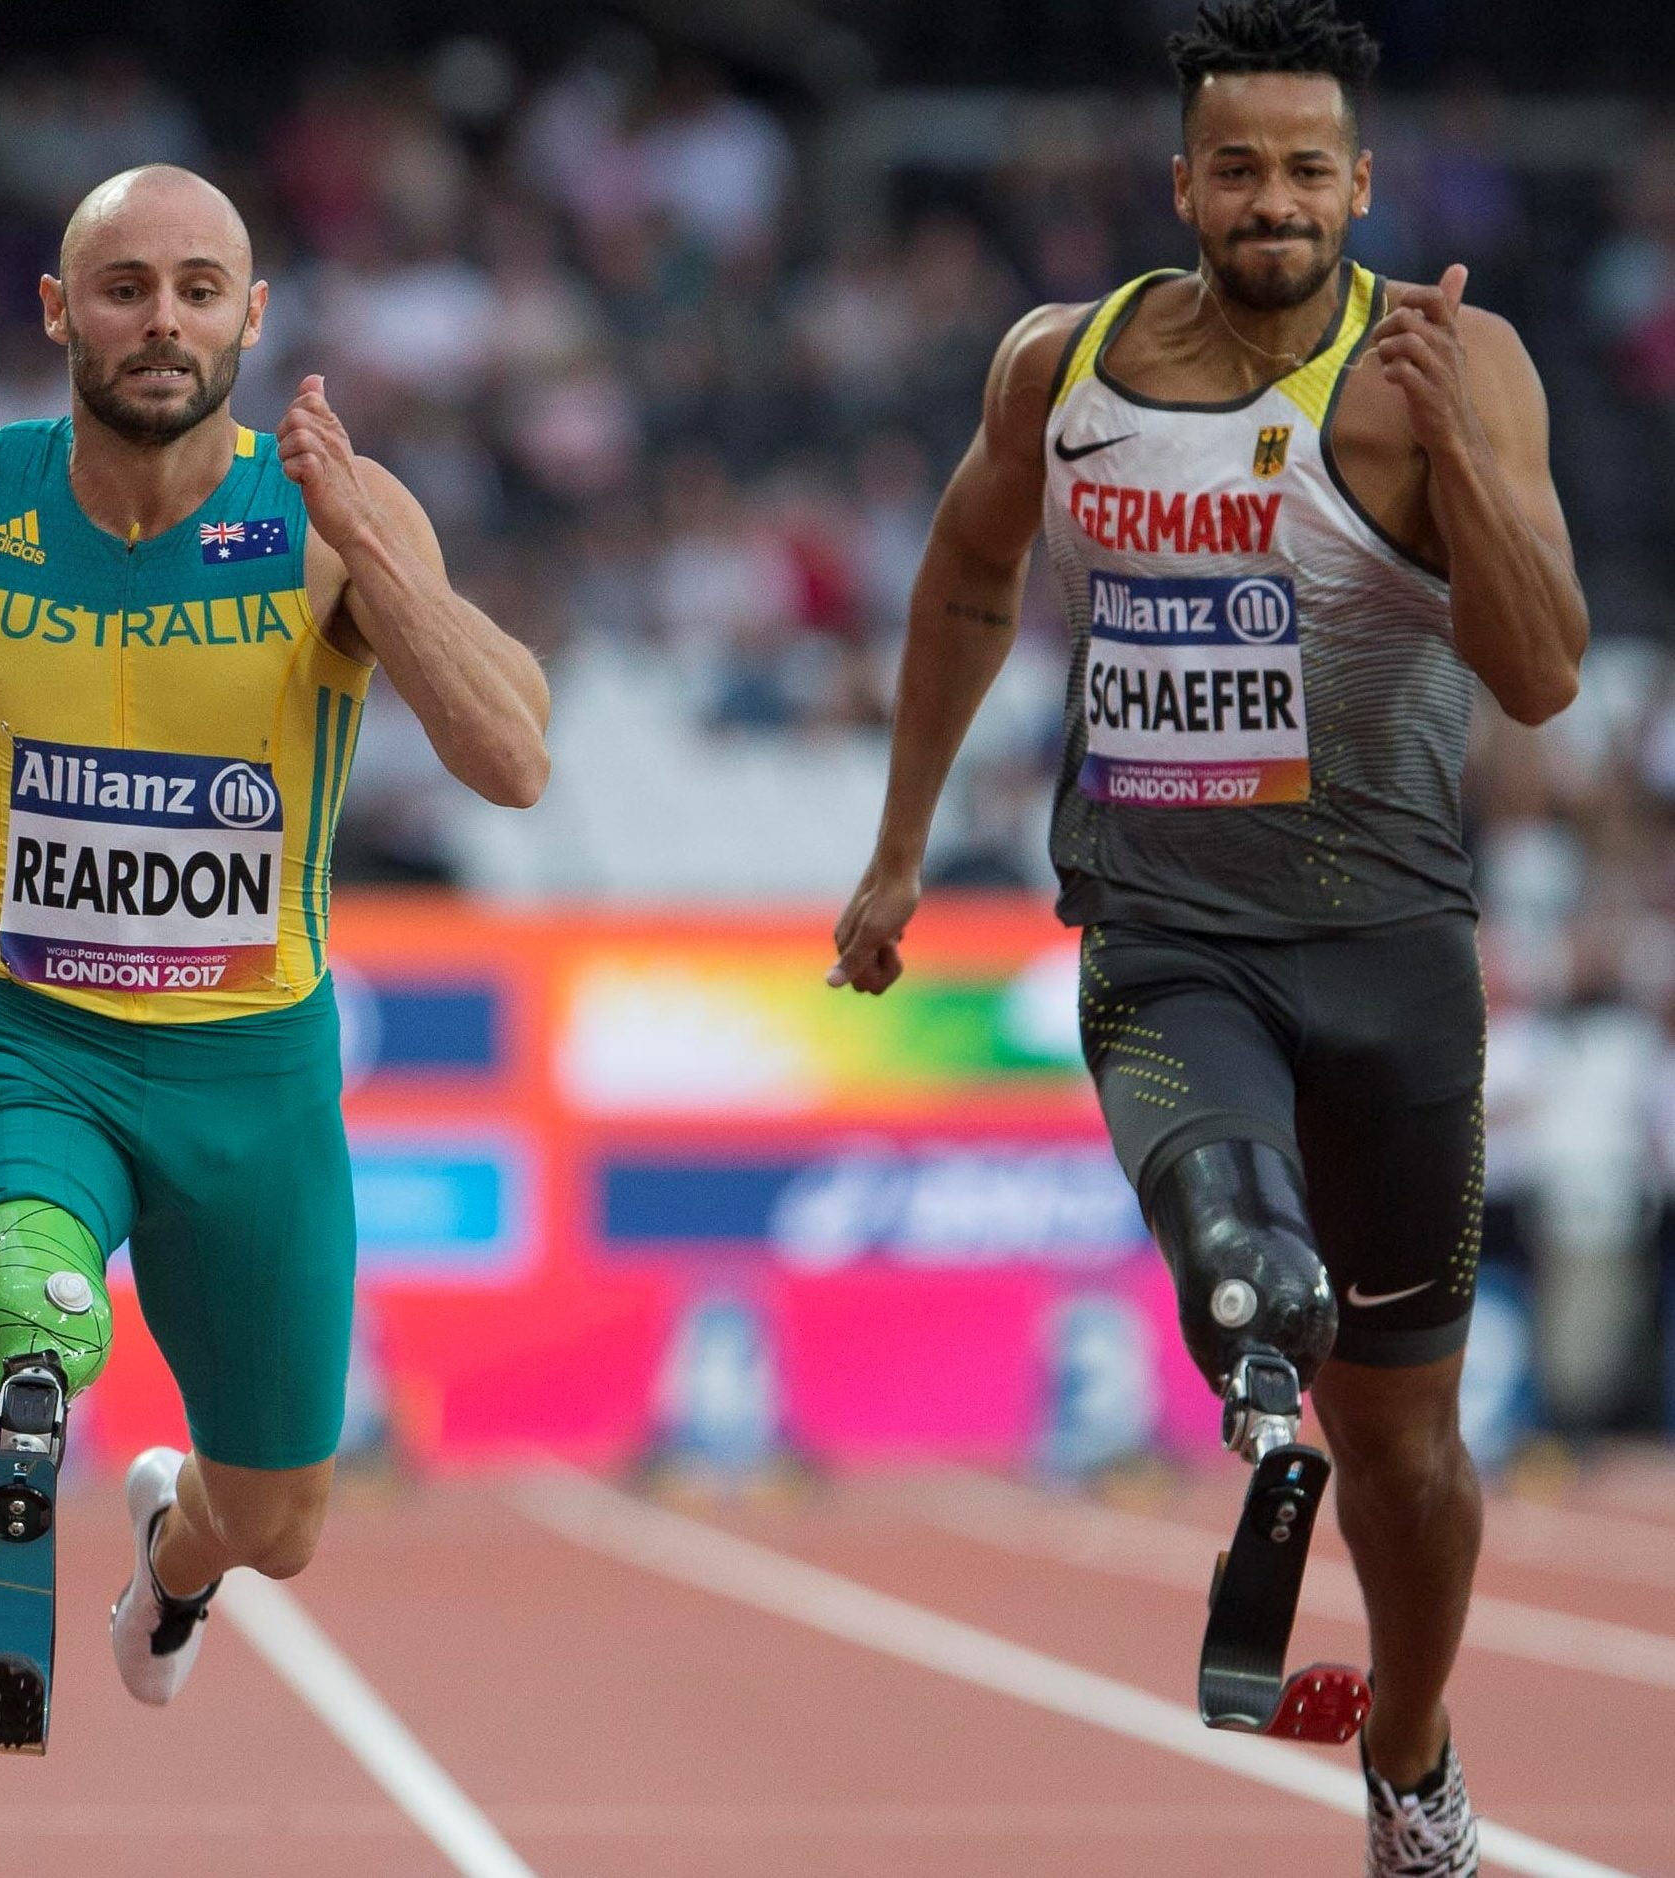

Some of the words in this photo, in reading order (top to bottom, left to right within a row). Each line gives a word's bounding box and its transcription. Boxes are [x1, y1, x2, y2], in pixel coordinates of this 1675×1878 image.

[1070, 480, 1283, 555] GERMANY
[1092, 579, 1216, 633] Allianz
[1089, 662, 1299, 732] SCHAEFER
[16, 750, 196, 815] Allianz
[1109, 775, 1199, 800] LONDON
[1203, 778, 1261, 800] 2017
[1129, 766, 1151, 776] Para
[12, 836, 272, 918] REARDON
[45, 957, 159, 987] LONDON
[163, 965, 226, 988] 2017
[46, 946, 77, 958] WORLD
[77, 948, 105, 961] Para
[106, 950, 156, 964] Athletics
[157, 954, 227, 965] CHAMPIONSHIPS
